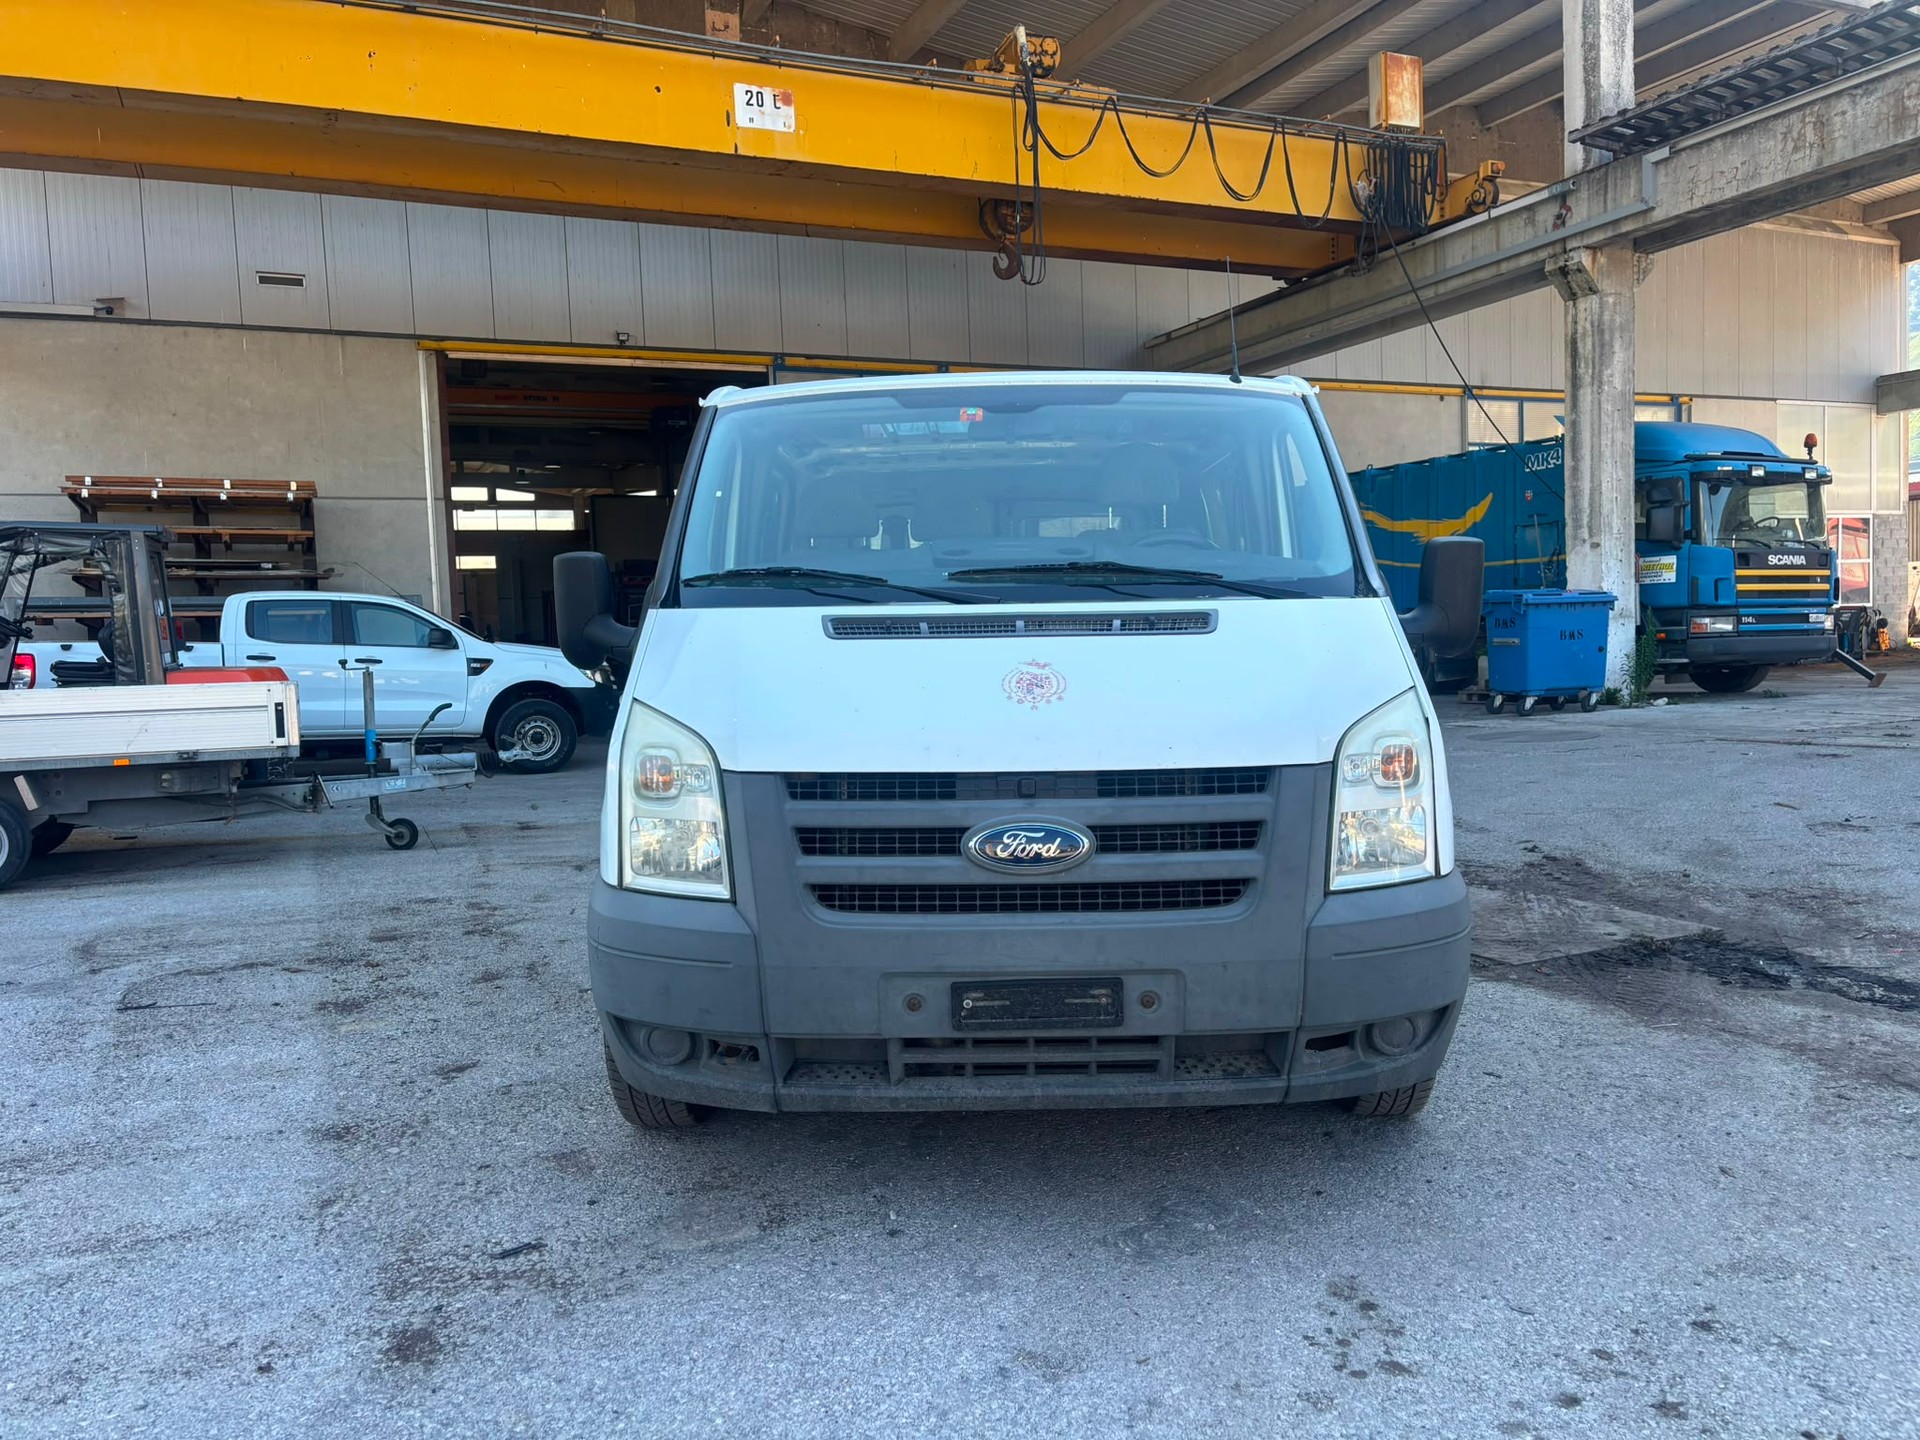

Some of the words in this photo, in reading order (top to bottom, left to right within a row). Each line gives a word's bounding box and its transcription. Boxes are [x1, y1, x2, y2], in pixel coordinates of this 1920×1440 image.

[745, 90, 764, 107] 20
[1525, 447, 1562, 472] MK4
[1767, 554, 1806, 566] SCANIA
[1560, 629, 1584, 641] BMS
[996, 830, 1061, 858] Ford
